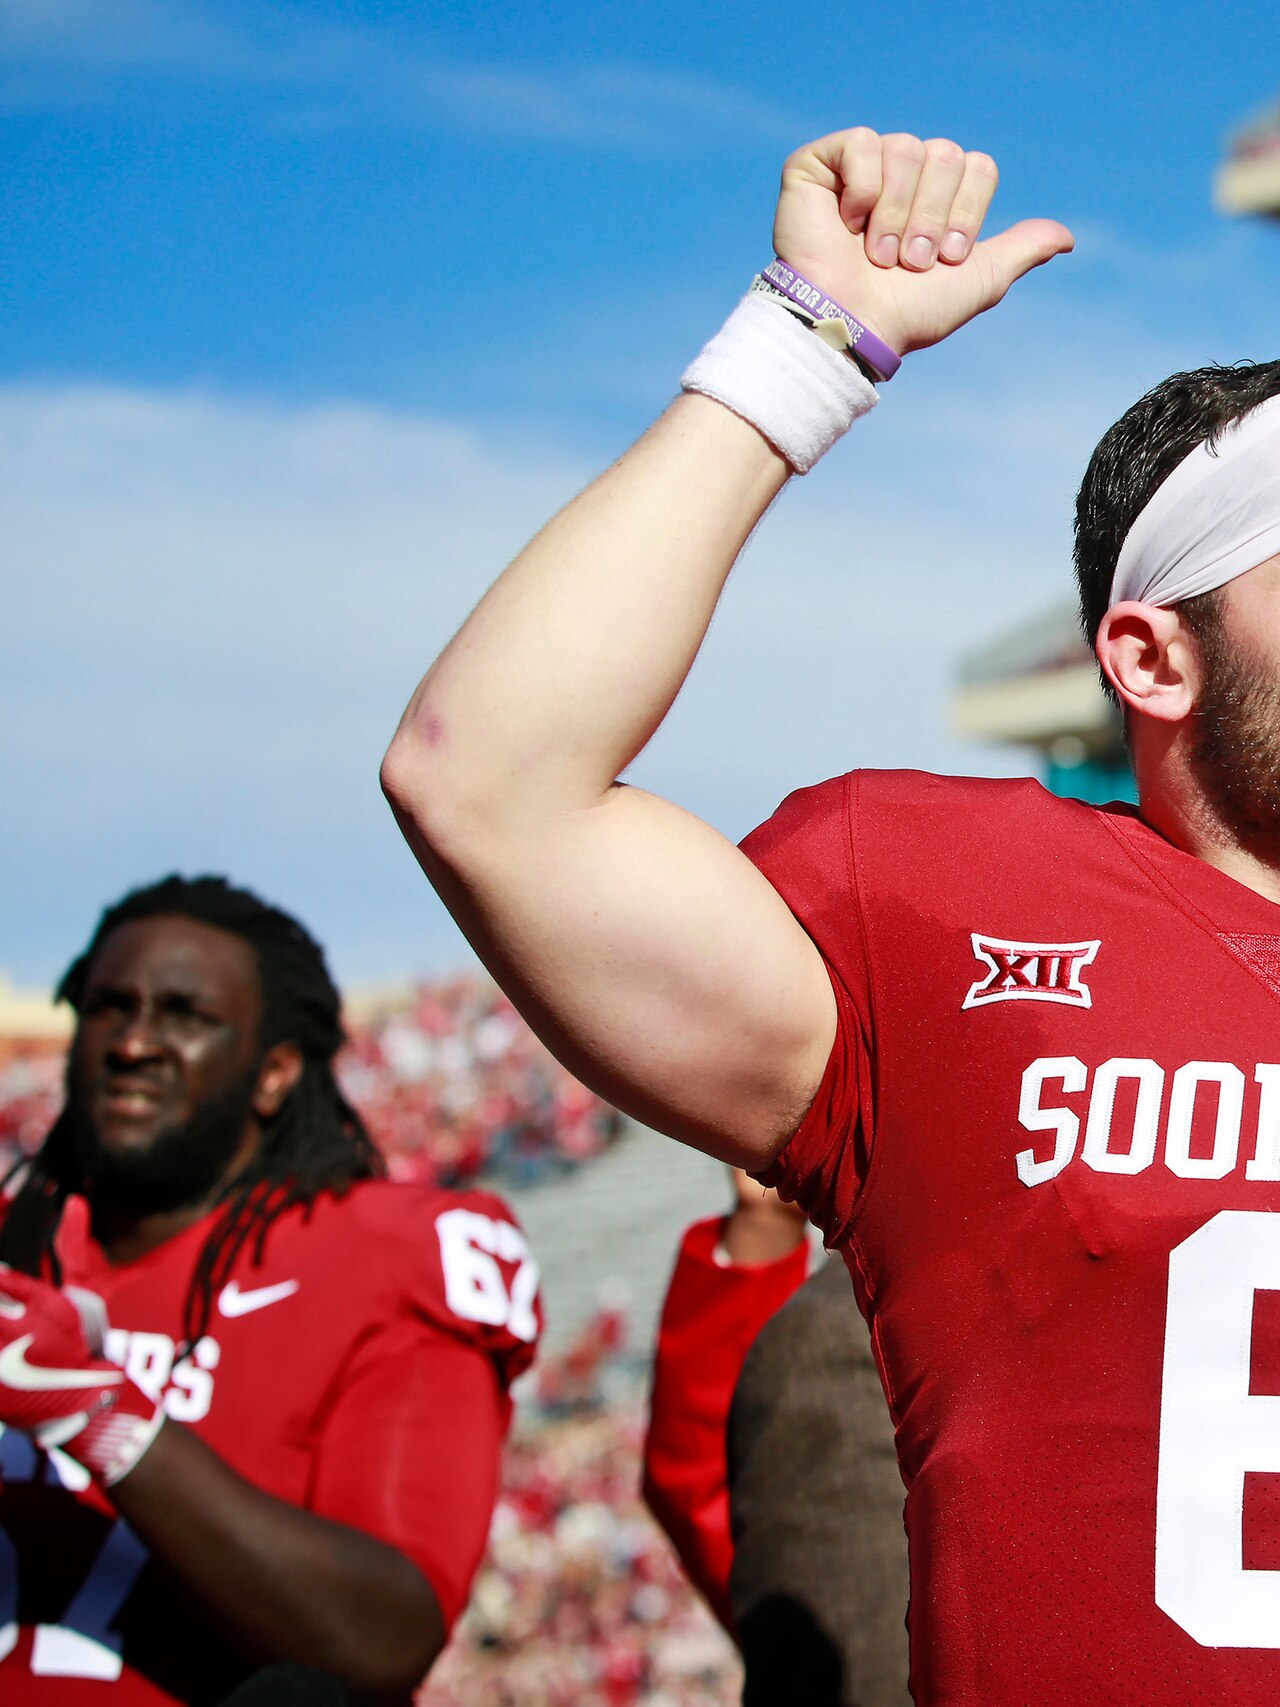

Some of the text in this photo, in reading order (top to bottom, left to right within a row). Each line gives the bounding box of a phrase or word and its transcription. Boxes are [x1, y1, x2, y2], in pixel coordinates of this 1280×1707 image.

[789, 278, 822, 308] FOR
[973, 942, 1090, 999] XII
[434, 1208, 540, 1343] 67
